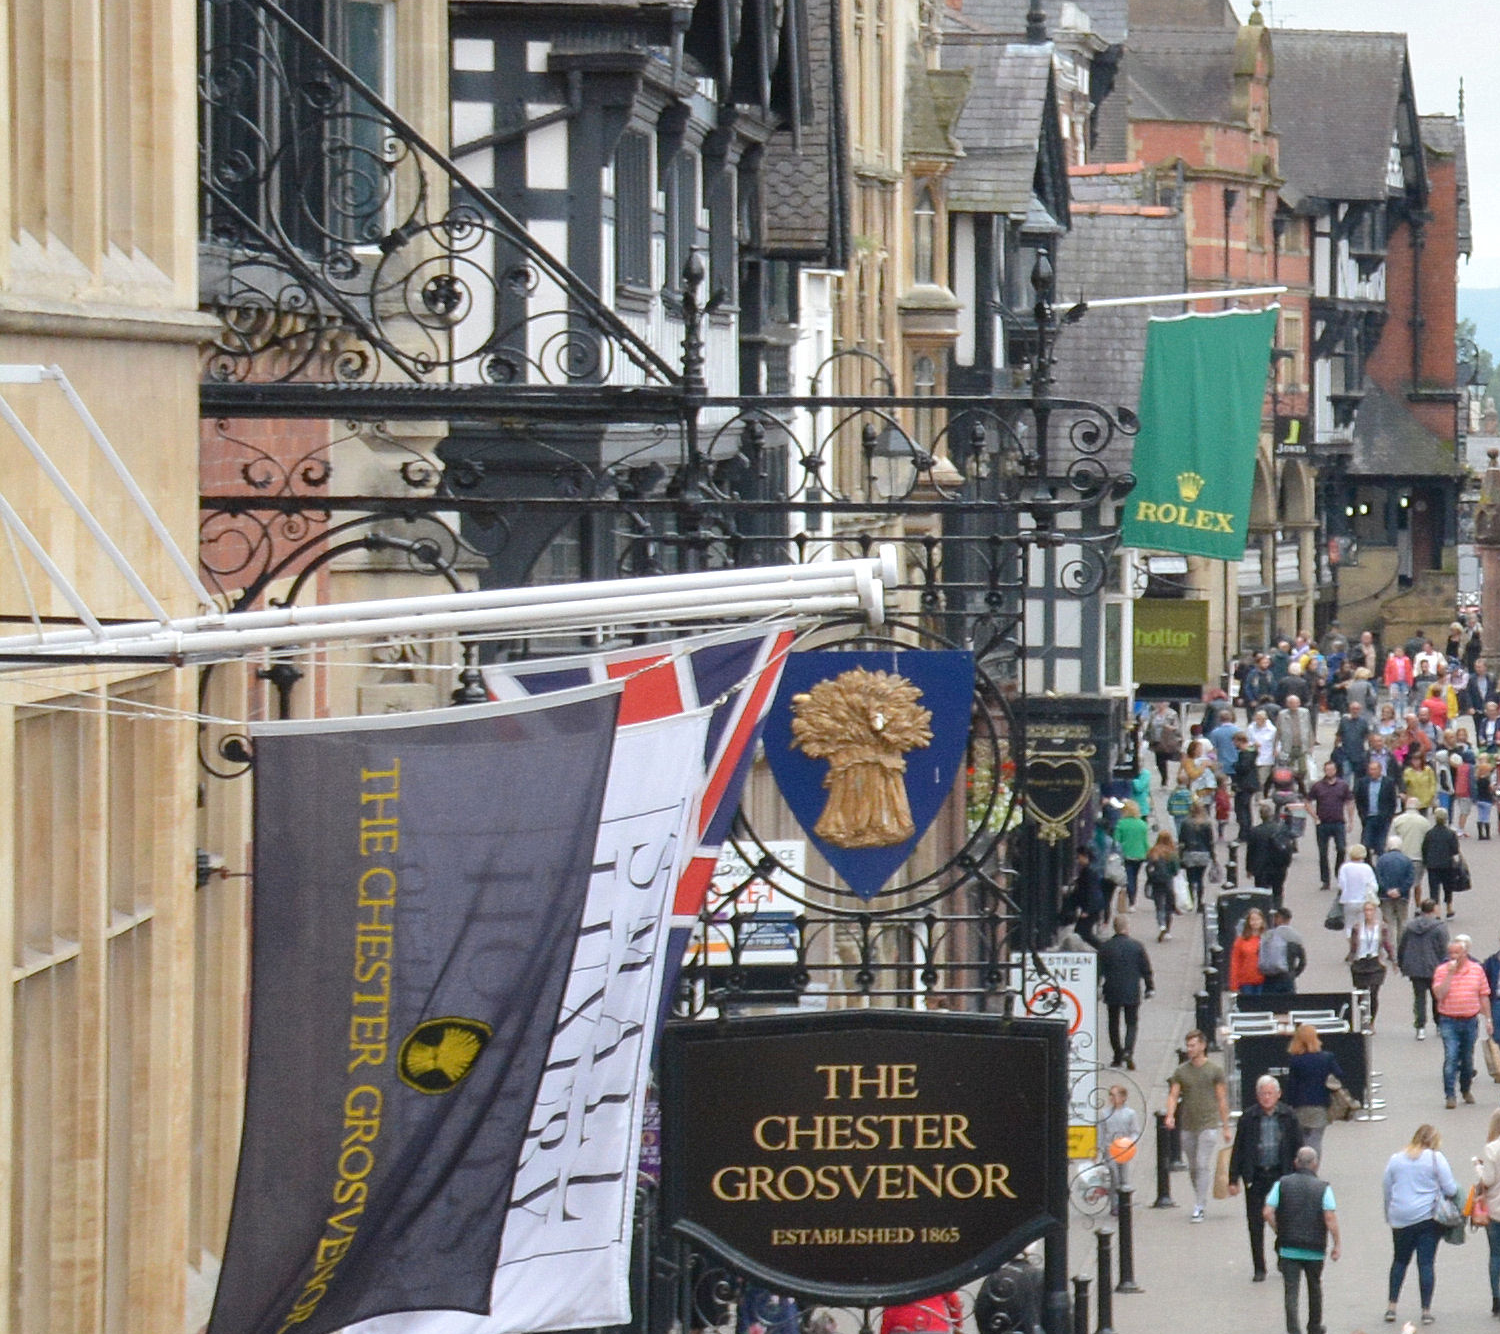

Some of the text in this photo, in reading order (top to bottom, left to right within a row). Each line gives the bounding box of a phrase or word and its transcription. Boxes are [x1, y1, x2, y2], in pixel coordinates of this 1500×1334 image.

[1136, 501, 1235, 533] ROLEX
[359, 759, 399, 856] THE
[348, 866, 398, 1074] CHESTER
[1026, 969, 1080, 982] ZNE
[816, 1064, 918, 1100] THE
[753, 1114, 977, 1151] CHESTER
[710, 1163, 1018, 1202] GROSVENOR
[772, 1227, 960, 1246] ESTABLISHED 1865
